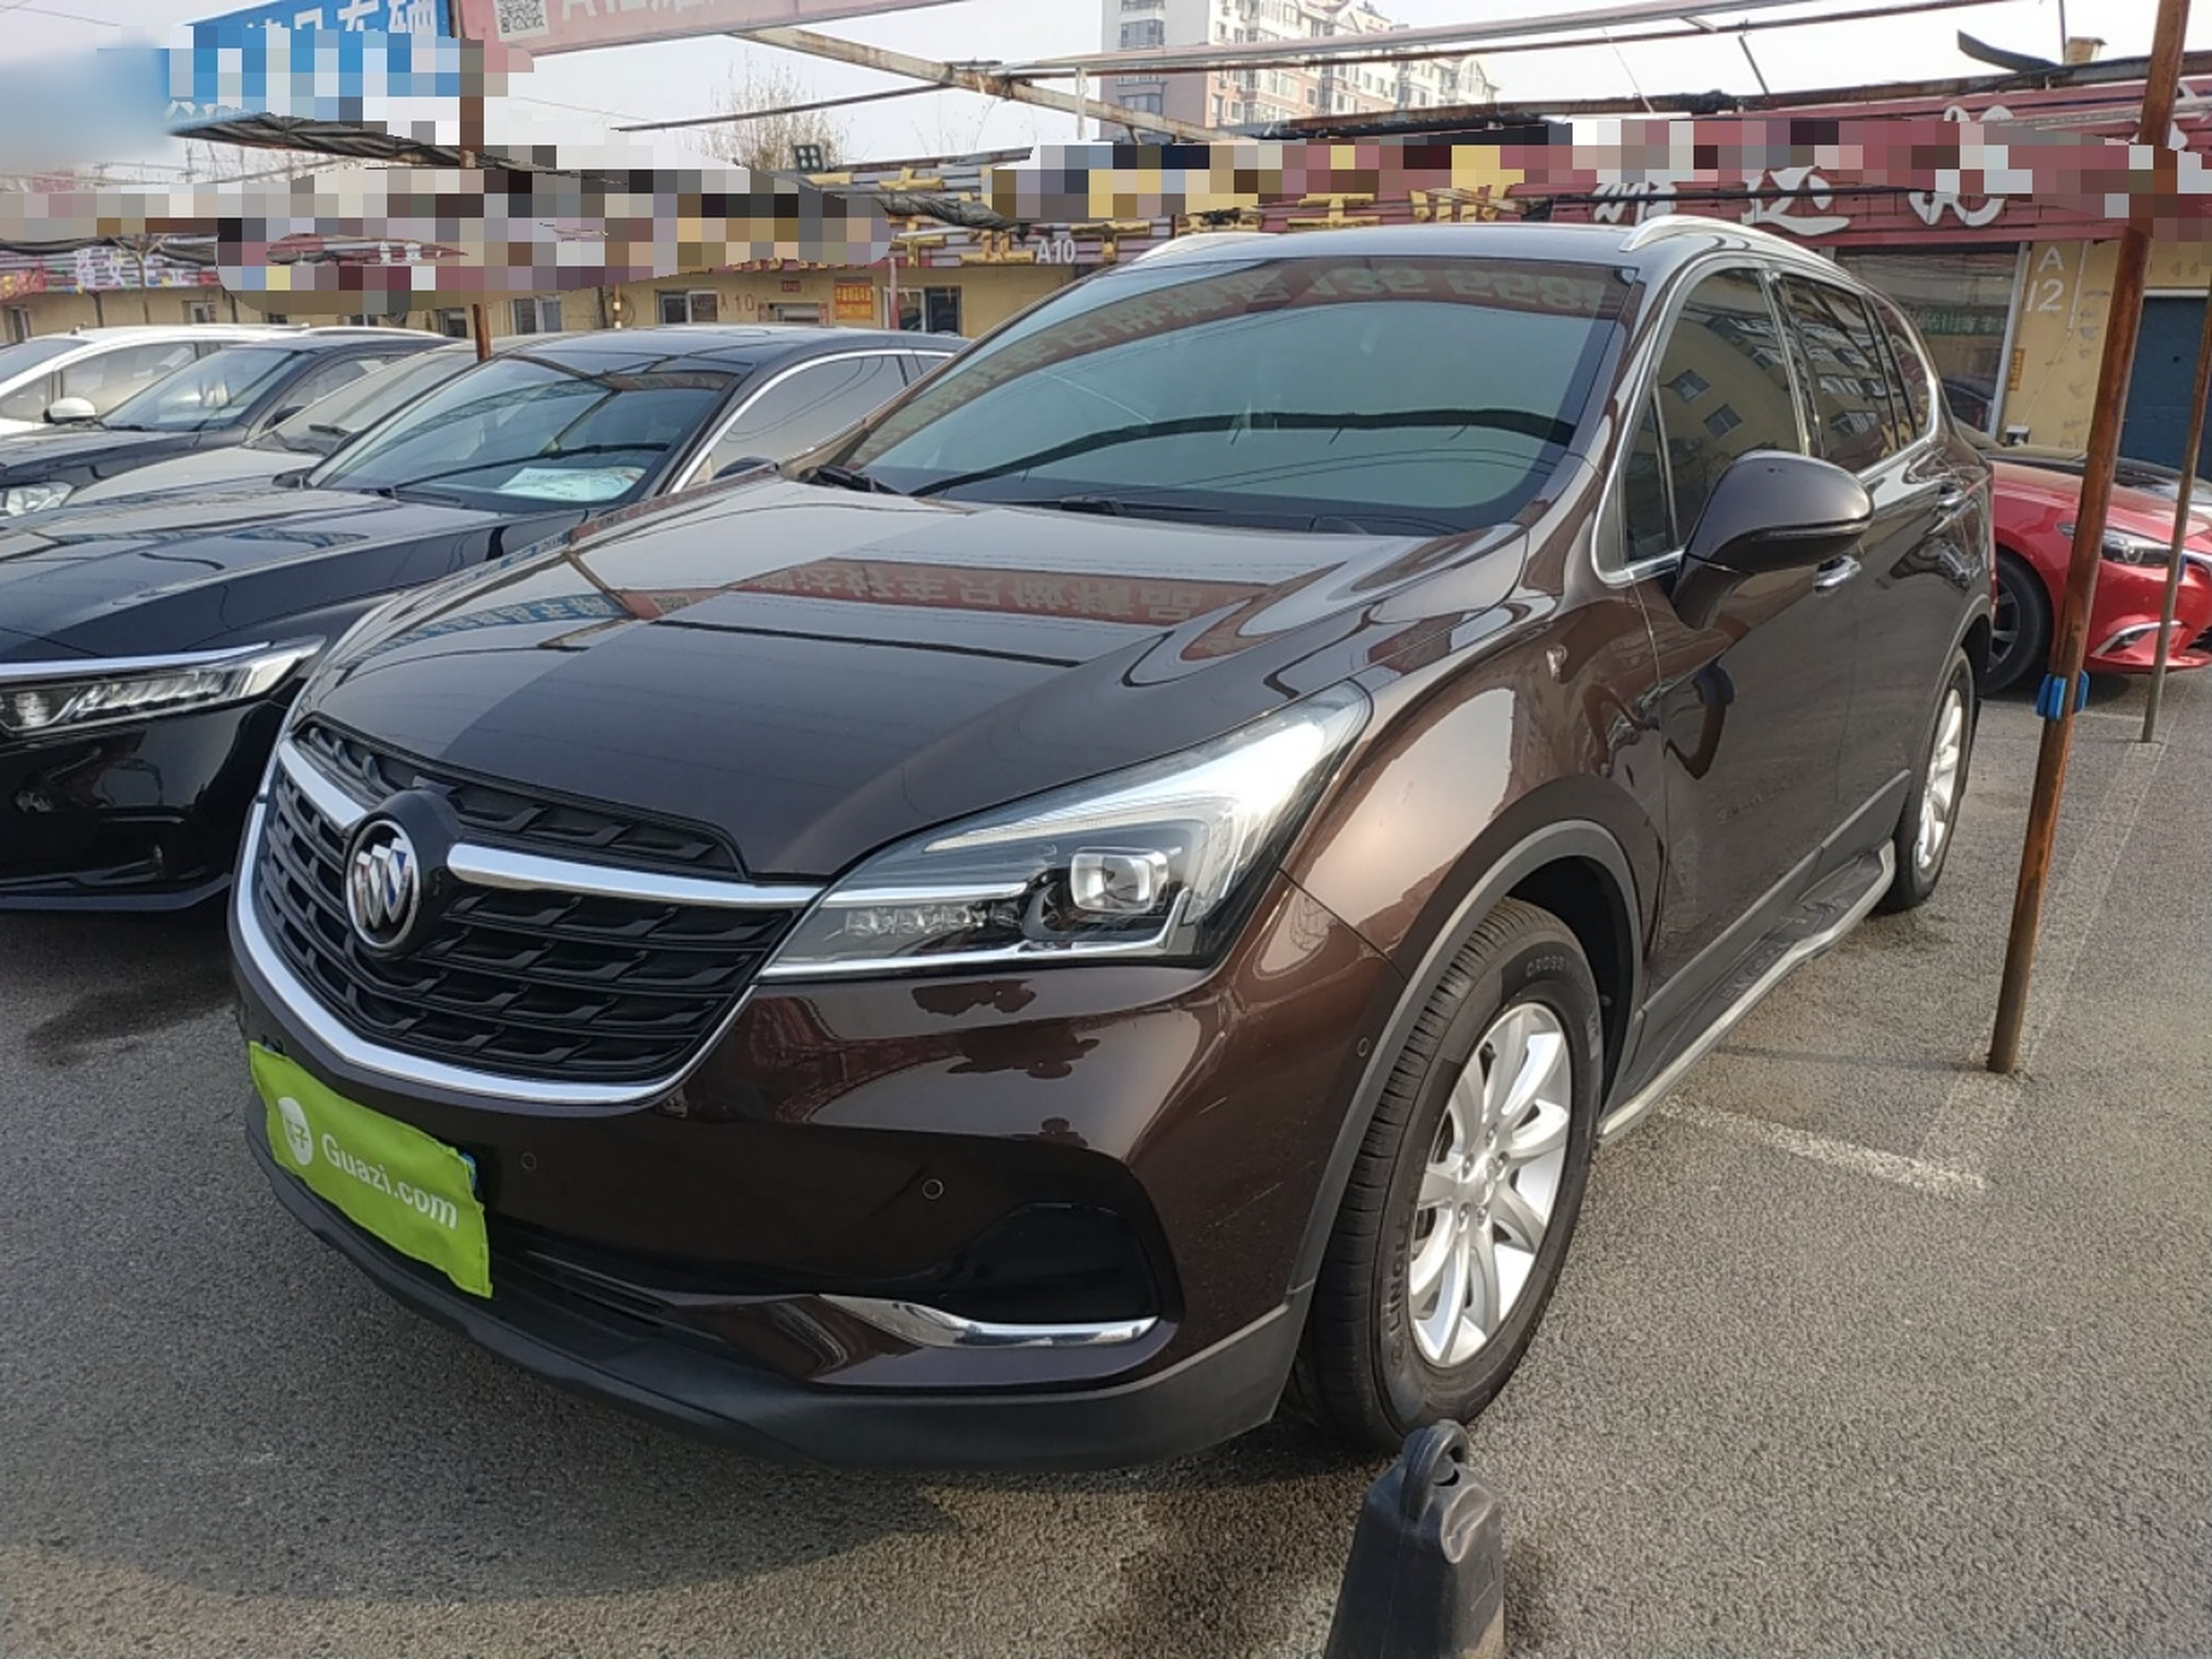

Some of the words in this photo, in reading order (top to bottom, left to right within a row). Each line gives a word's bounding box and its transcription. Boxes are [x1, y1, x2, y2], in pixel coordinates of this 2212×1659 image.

[1036, 238, 1075, 264] A10
[2037, 246, 2064, 272] A
[2026, 279, 2064, 312] 12
[321, 1133, 457, 1230] Guazi.com
